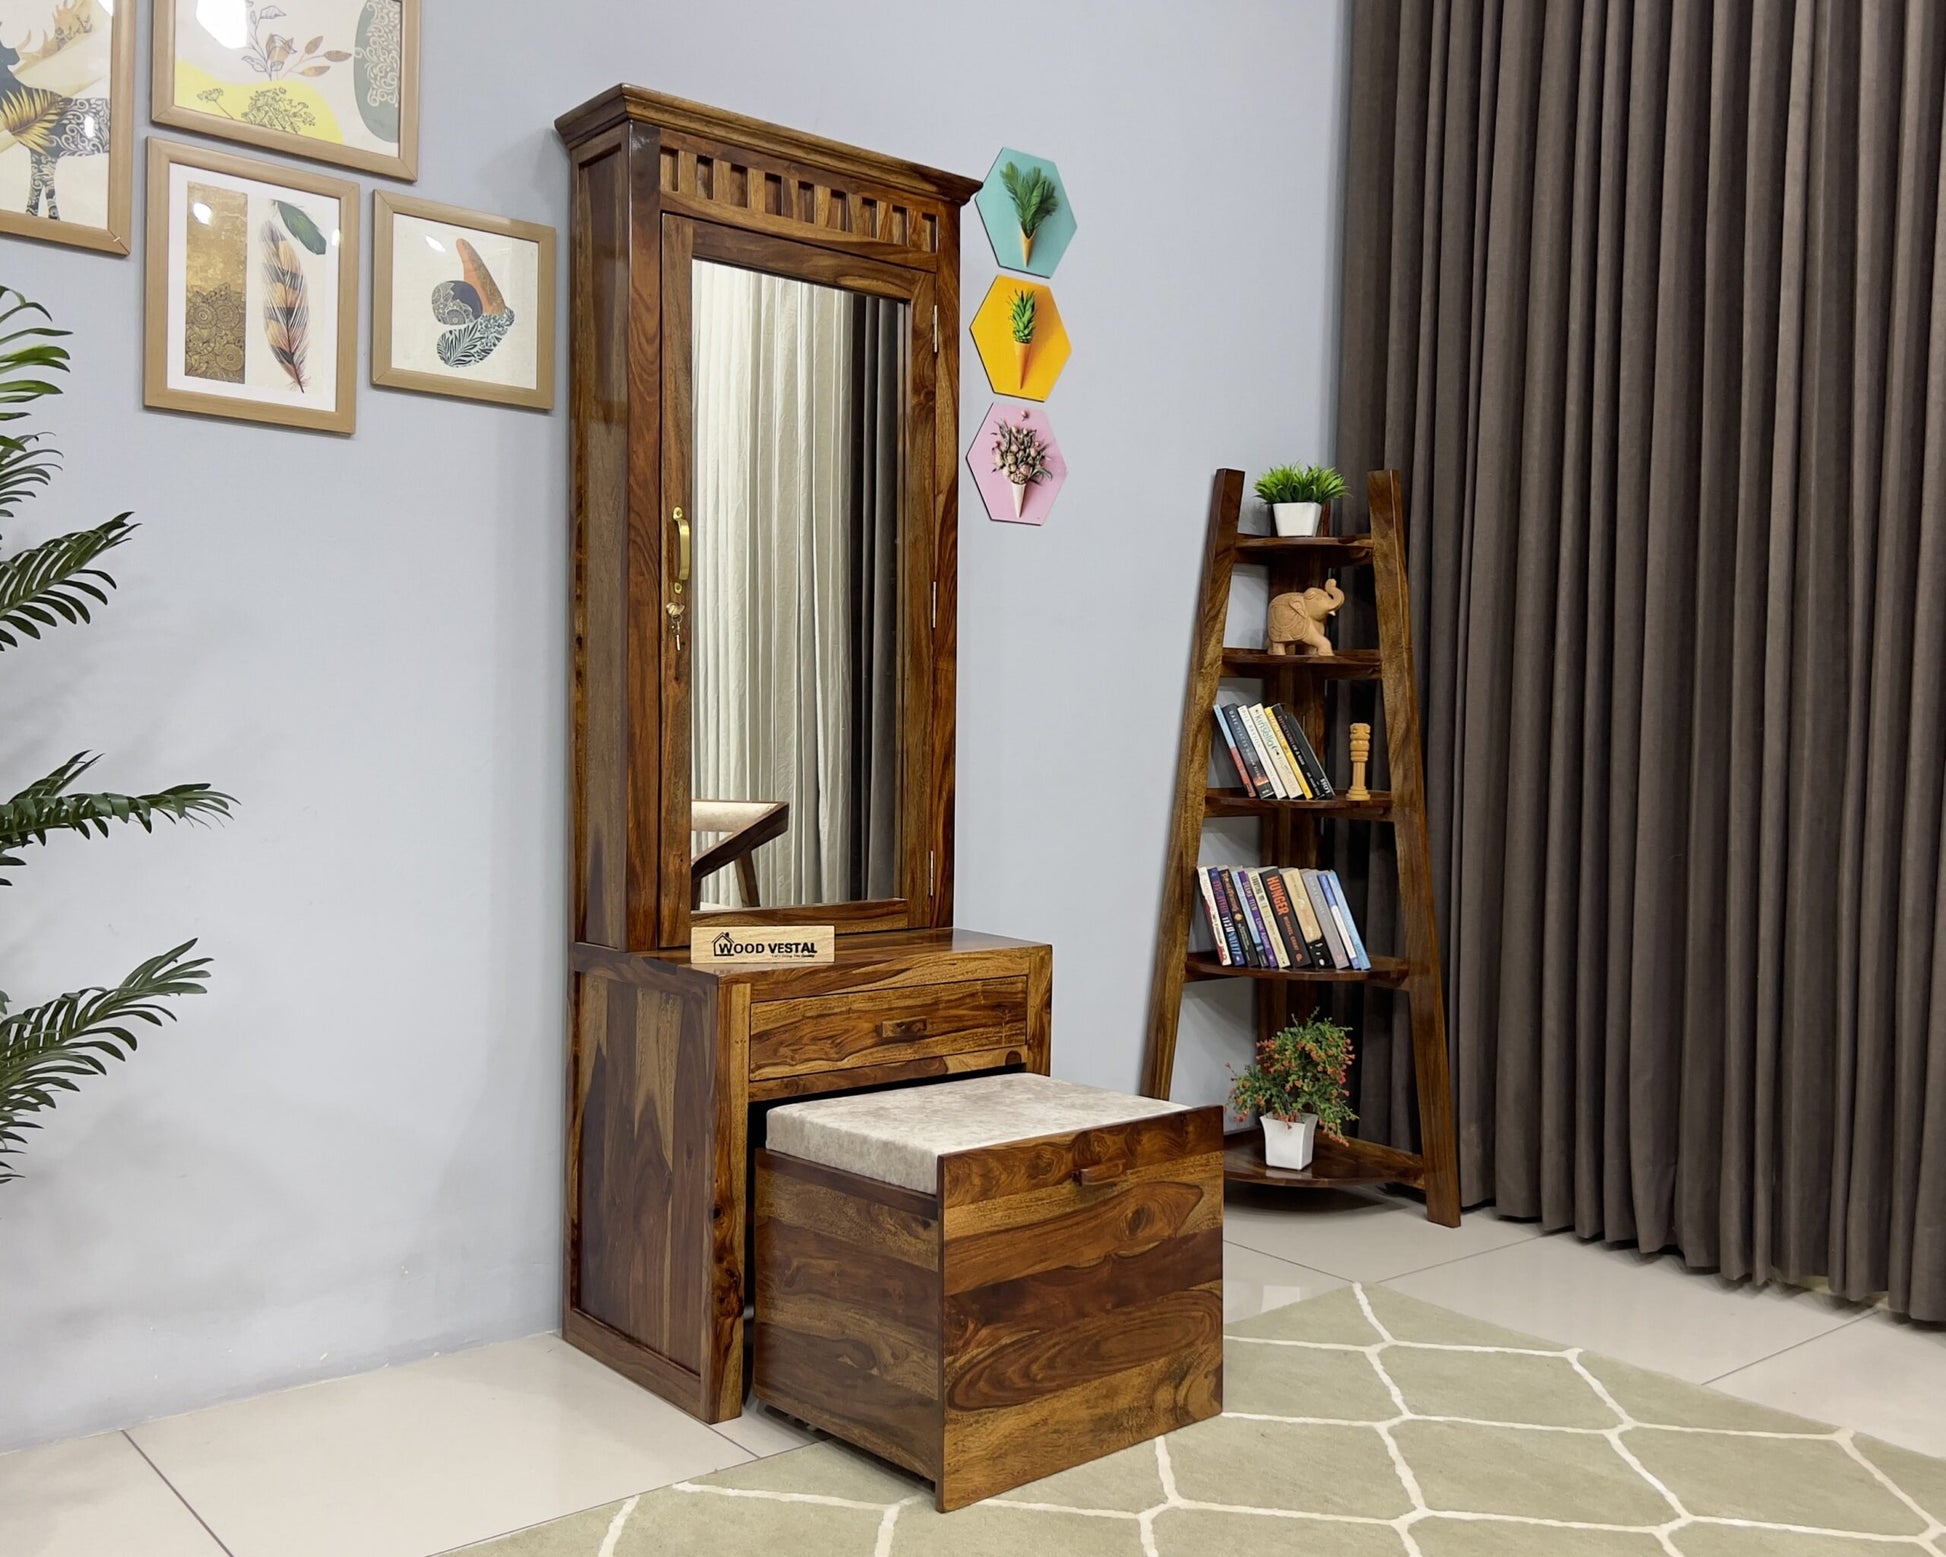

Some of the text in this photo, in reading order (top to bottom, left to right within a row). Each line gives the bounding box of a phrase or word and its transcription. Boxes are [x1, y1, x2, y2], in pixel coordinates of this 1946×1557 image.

[1266, 875, 1290, 916] HUNGER
[718, 942, 818, 954] WOOD VESTAL
